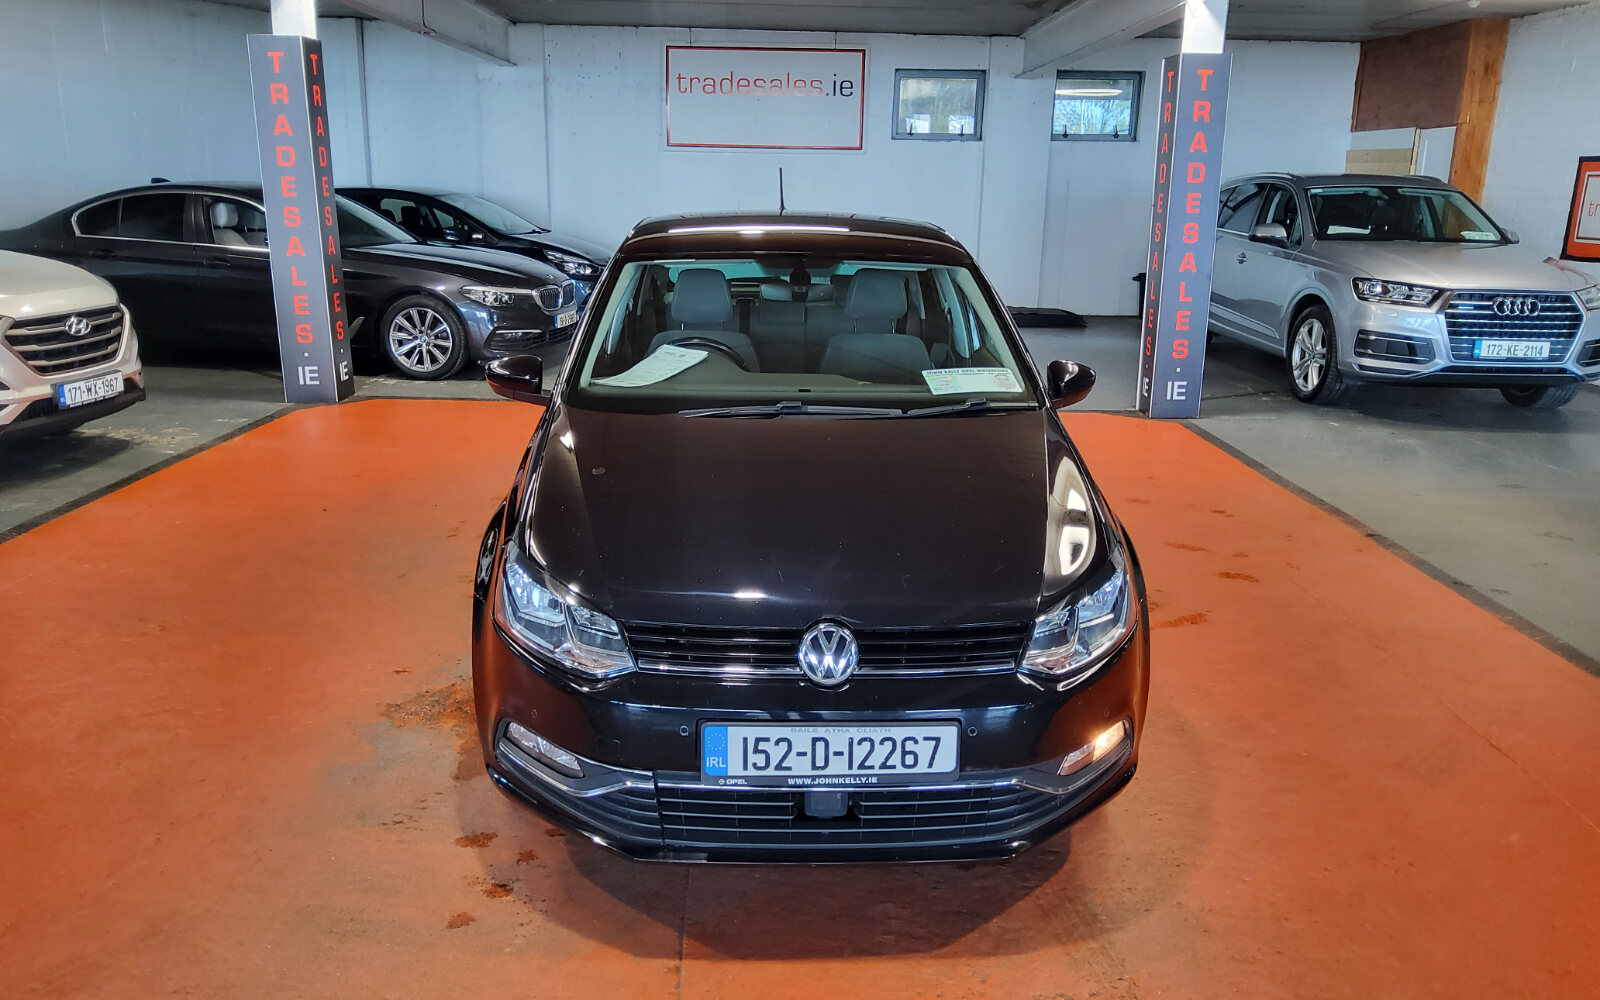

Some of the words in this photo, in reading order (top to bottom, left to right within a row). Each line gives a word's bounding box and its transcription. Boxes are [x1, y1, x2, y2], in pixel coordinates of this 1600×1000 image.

[675, 70, 855, 98] tradesales.ie
[1486, 343, 1544, 357] 172-KE-2114
[67, 377, 119, 403] 171-WX-1967
[742, 737, 941, 771] 152-D-12267
[706, 757, 727, 768] IRL
[726, 778, 748, 786] OPEL
[787, 776, 878, 786] WWW.JOHNKELLY.IE
